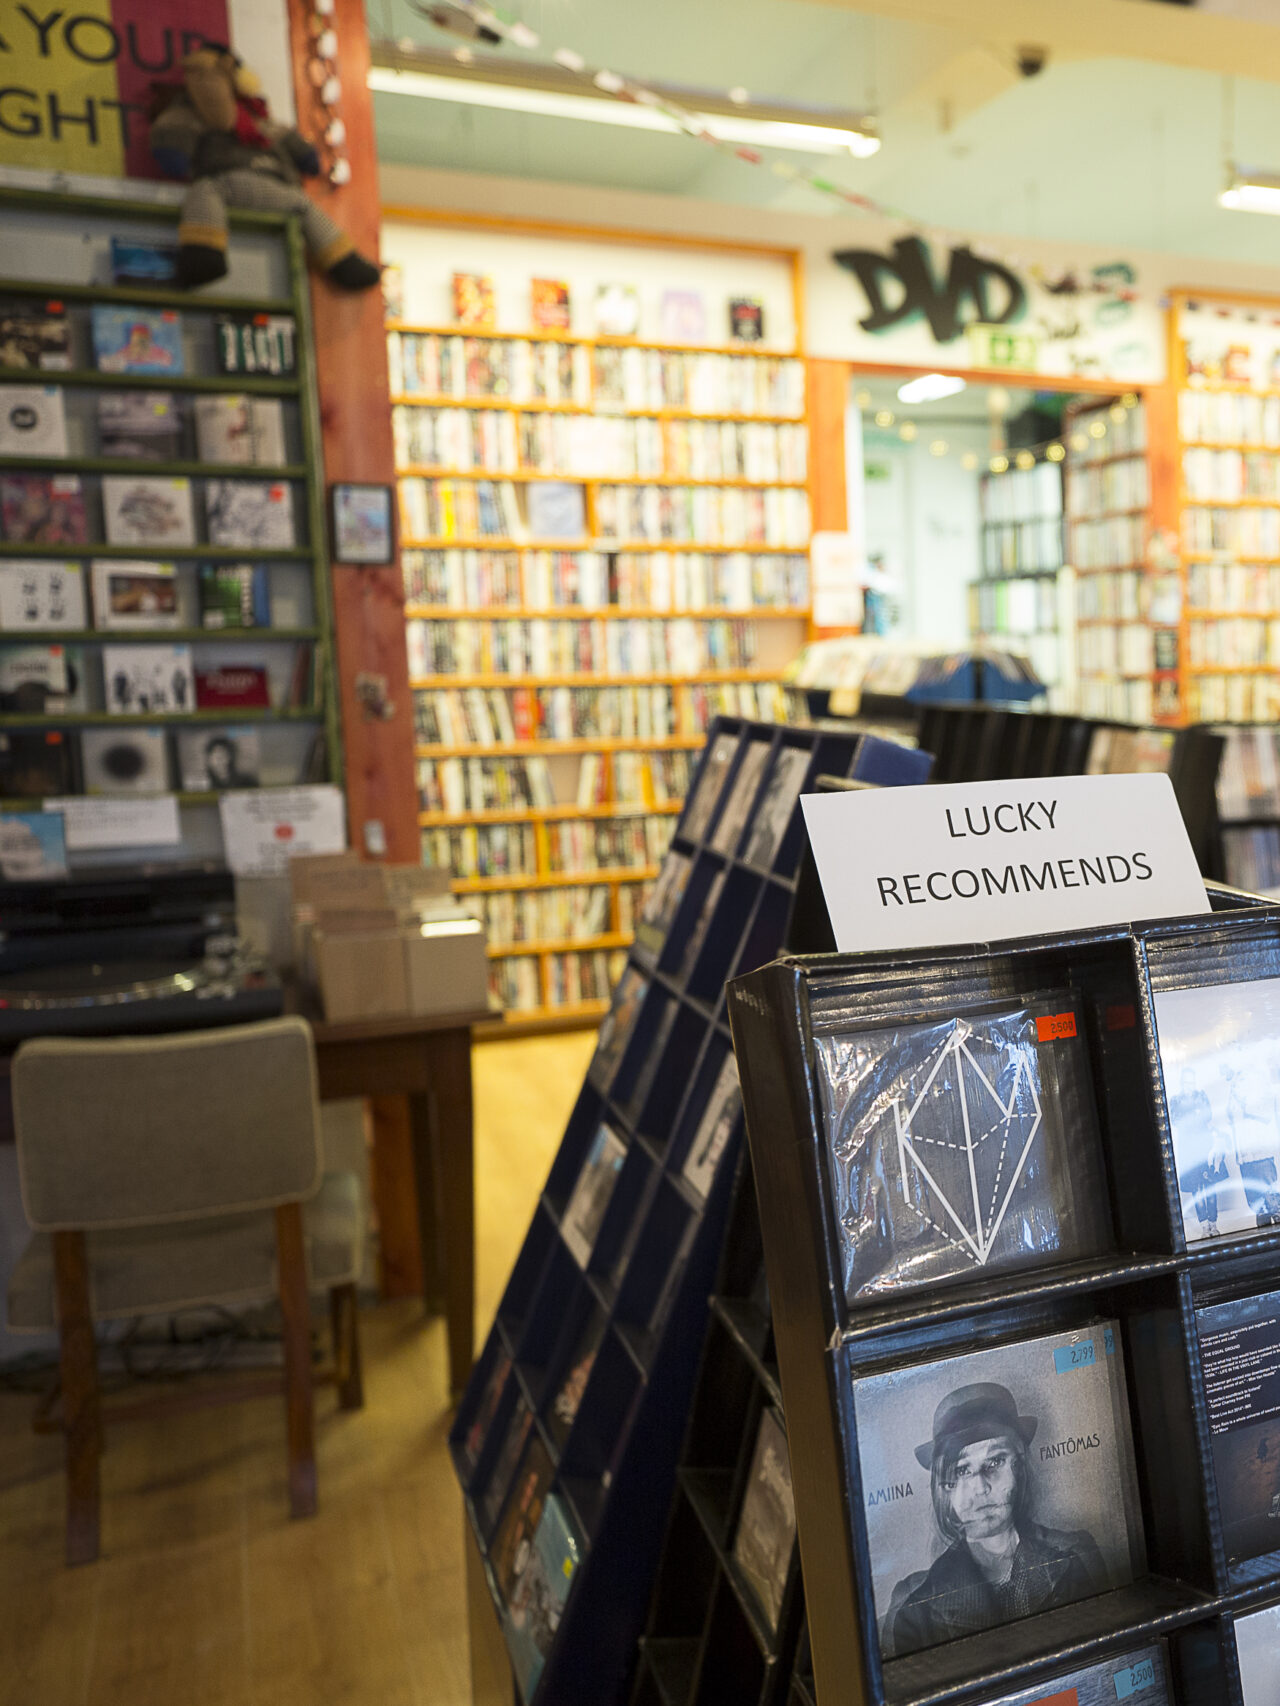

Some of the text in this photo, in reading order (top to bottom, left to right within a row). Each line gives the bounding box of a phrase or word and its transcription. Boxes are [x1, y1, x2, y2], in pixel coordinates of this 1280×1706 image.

[832, 235, 1028, 343] DVD
[945, 800, 1057, 838] LUCKY
[876, 852, 1153, 906] RECOMMENDS
[1039, 1433, 1100, 1461] FANTÔMAS
[867, 1482, 914, 1507] AMIINA
